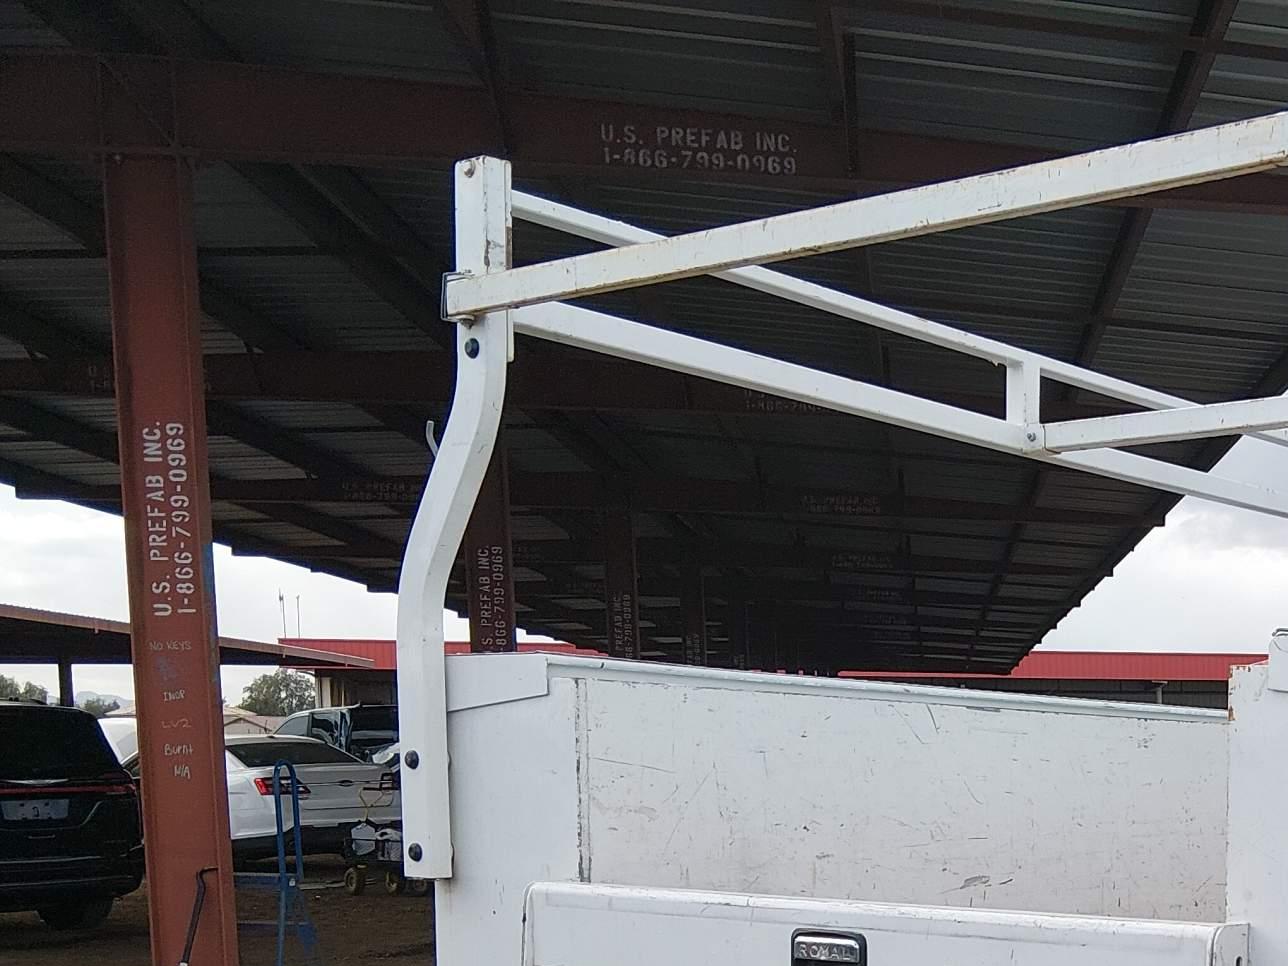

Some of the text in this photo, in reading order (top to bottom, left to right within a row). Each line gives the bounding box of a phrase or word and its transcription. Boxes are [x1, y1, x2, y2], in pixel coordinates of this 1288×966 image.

[600, 123, 798, 154] U.S. PREFAB INC.
[142, 421, 172, 617] U.S. PREFAB INC.
[165, 422, 197, 615] 1-866-799-0969
[477, 545, 490, 569] INC.
[478, 576, 492, 626] PREFAB
[491, 545, 507, 652] -866-799-0969
[149, 640, 192, 652] NO KEYS
[799, 943, 851, 961] ROYAL
